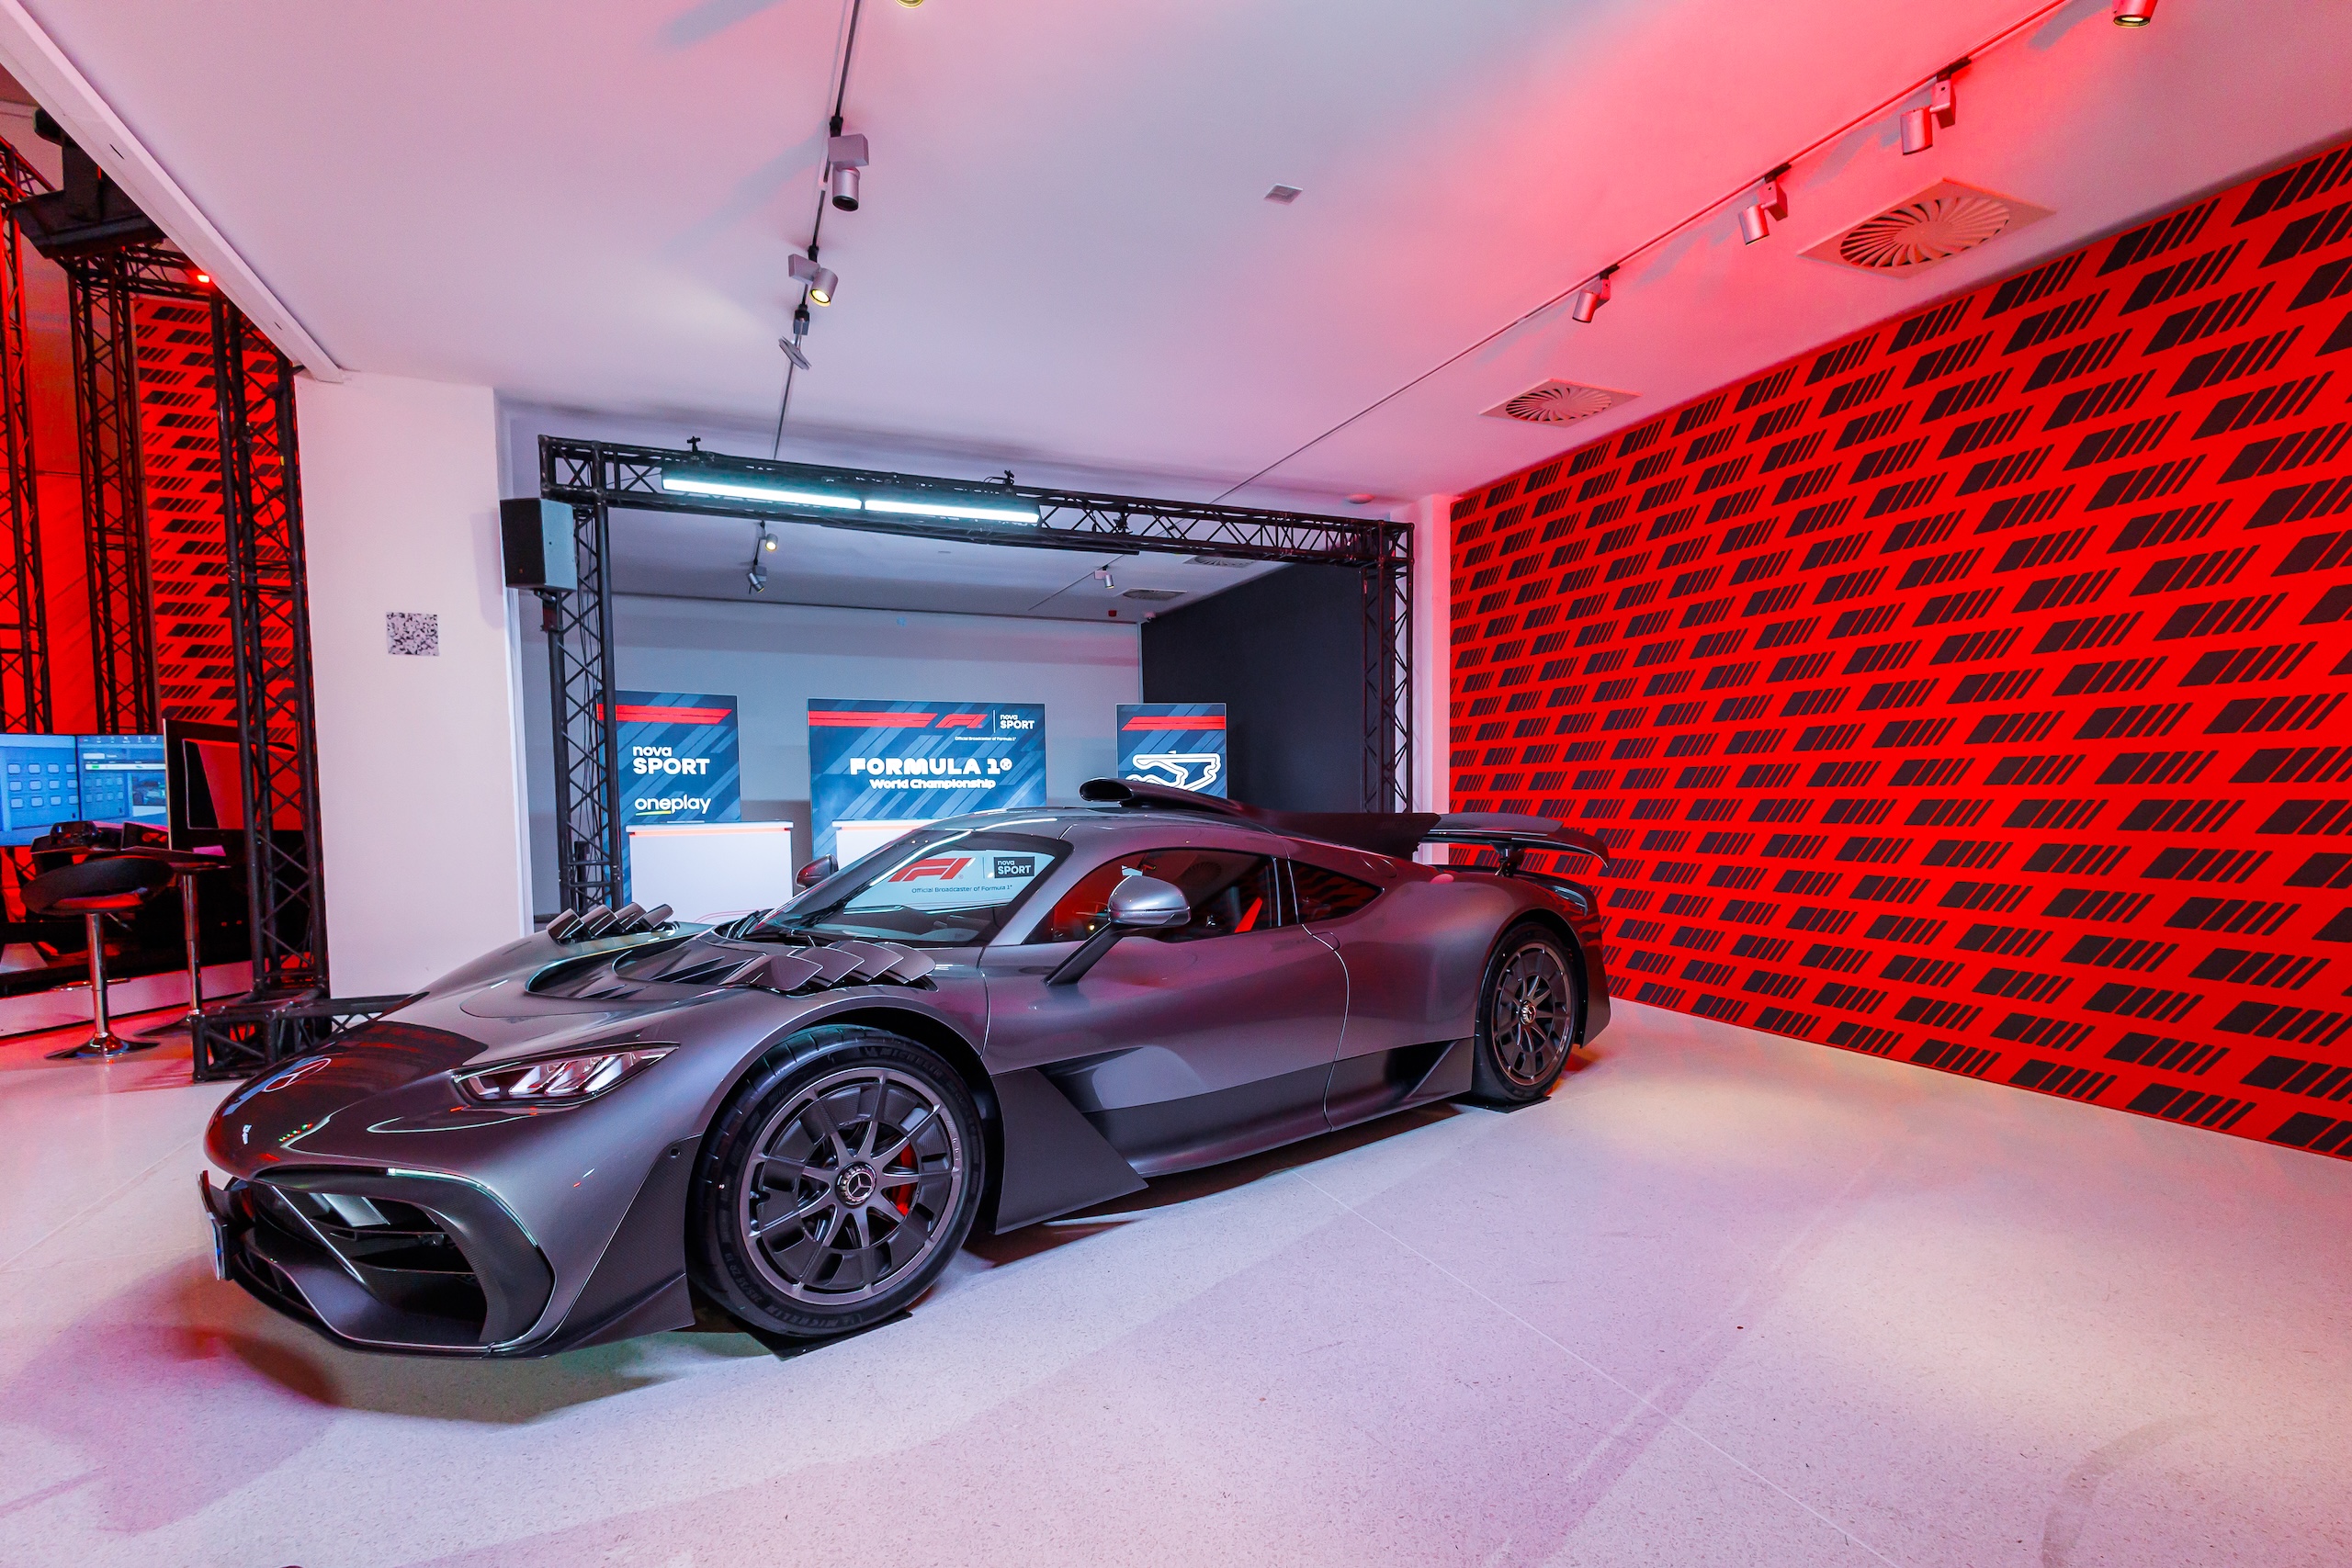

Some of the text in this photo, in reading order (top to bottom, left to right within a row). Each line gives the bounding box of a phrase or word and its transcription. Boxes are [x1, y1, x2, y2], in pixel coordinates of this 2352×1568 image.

[1000, 720, 1035, 729] SPORT
[632, 746, 672, 757] nova
[633, 757, 710, 775] SPORT
[850, 757, 981, 775] FORMULA
[869, 778, 996, 790] World Championship
[634, 794, 711, 815] oneplay
[997, 865, 1032, 875] SPORT
